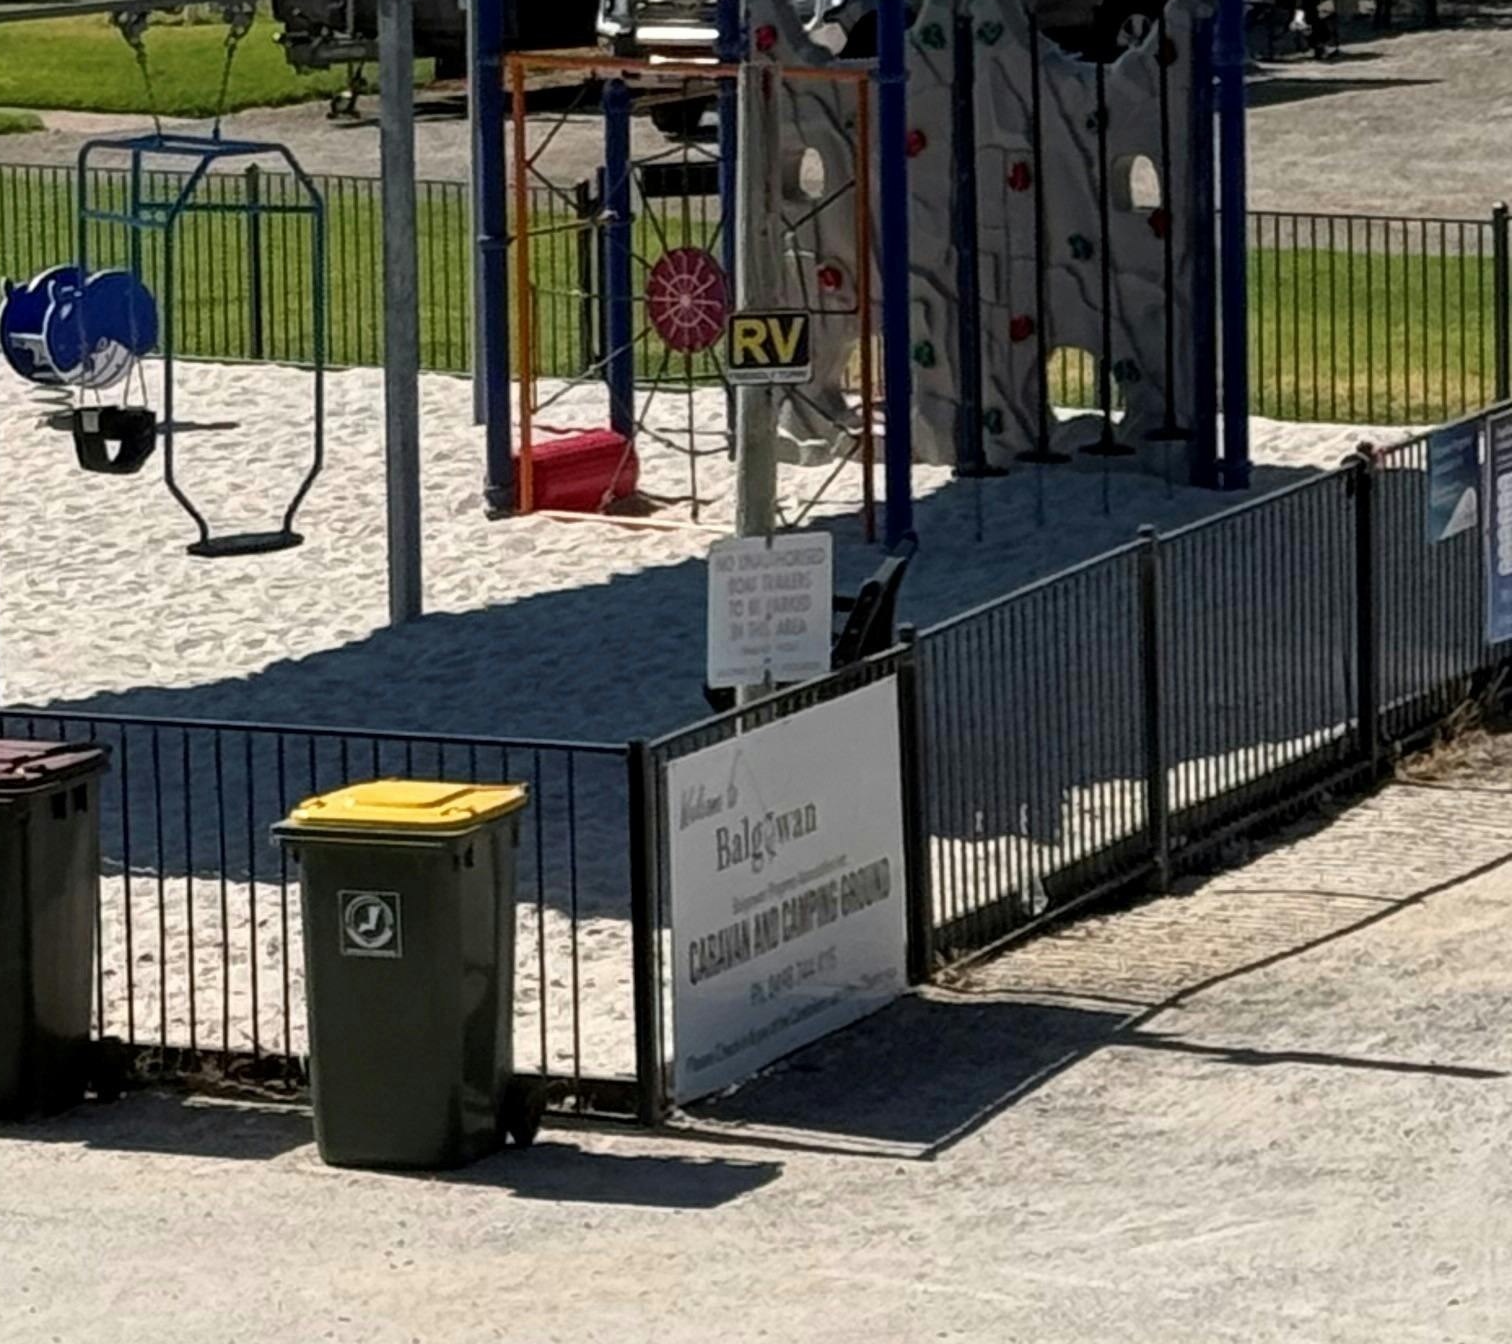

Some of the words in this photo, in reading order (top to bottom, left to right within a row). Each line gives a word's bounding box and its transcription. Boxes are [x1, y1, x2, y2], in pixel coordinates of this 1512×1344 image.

[733, 317, 805, 365] RV
[715, 802, 818, 875] Balgowan
[689, 918, 752, 986] CARAVAN
[753, 906, 780, 957] AND
[781, 879, 839, 943] CAMPING
[840, 856, 891, 918] GROUND
